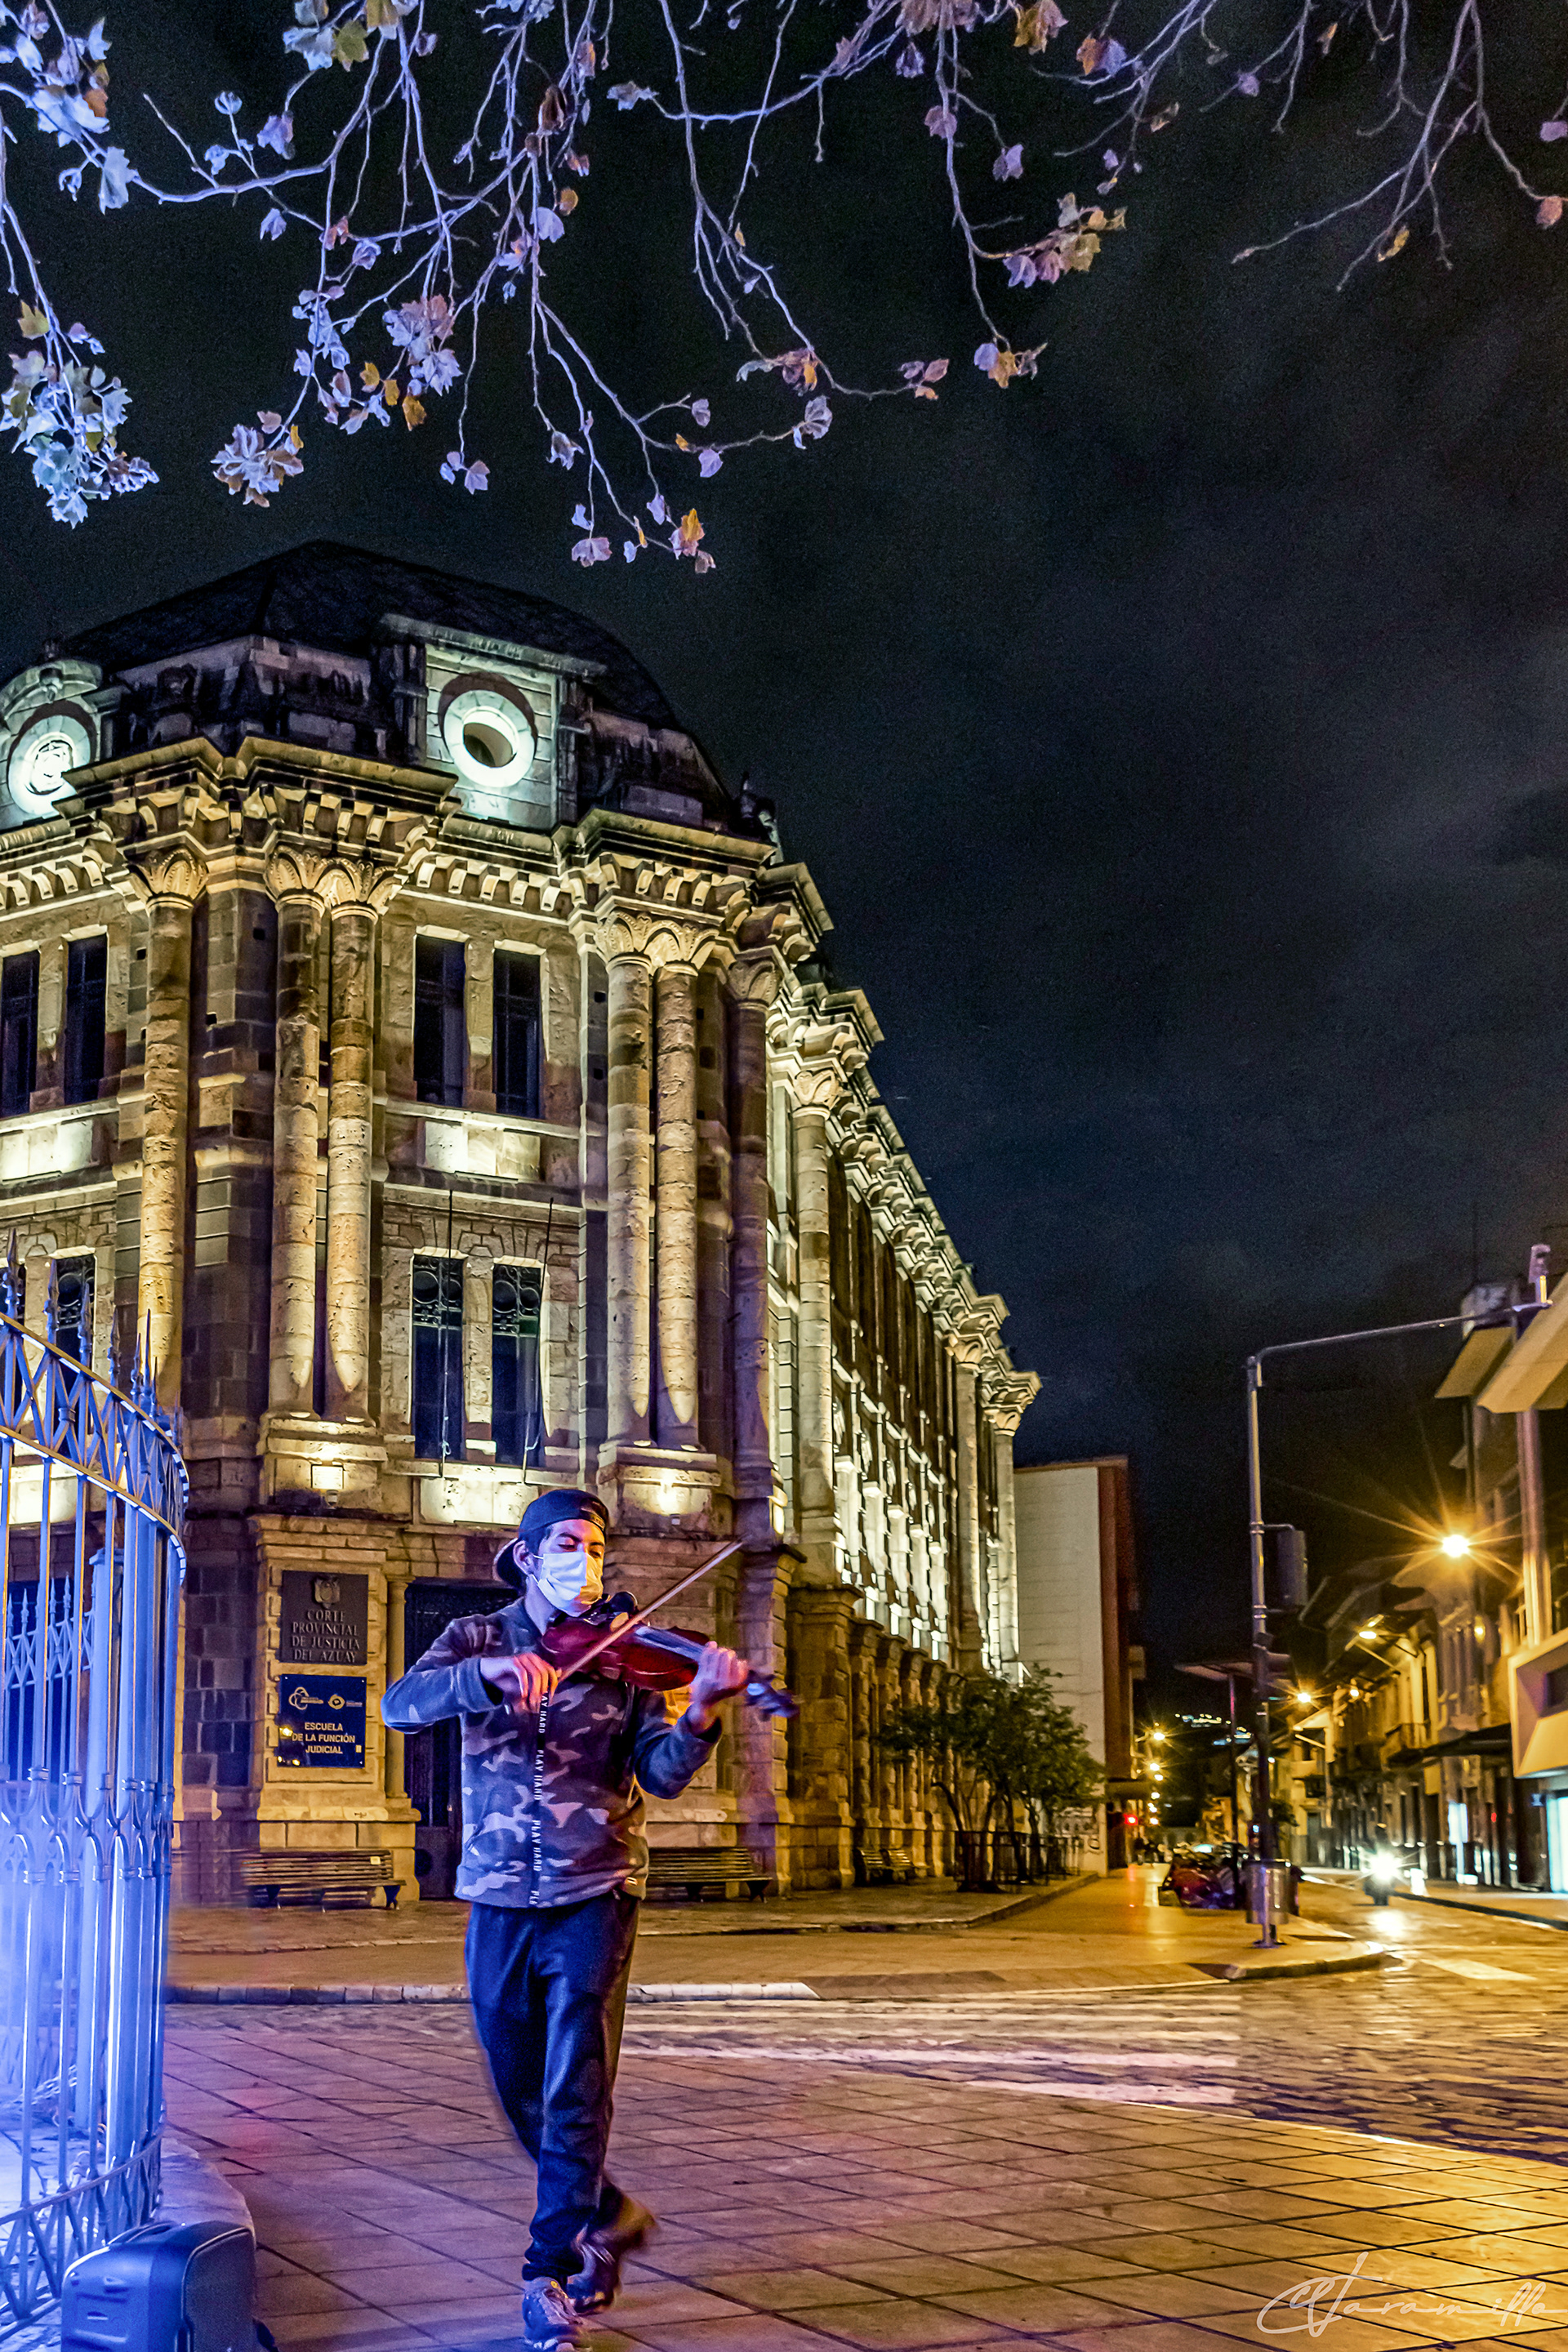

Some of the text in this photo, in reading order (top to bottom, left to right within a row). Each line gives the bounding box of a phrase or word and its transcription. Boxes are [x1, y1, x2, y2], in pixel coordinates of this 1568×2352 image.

[307, 1609, 345, 1622] CORTE
[292, 1621, 357, 1636] PROVINCIAL
[292, 1635, 359, 1650] DE JUSTICIA
[294, 1649, 355, 1663] DEL AZUAY
[304, 1722, 343, 1731] ESCUELA
[538, 1710, 547, 1734] HARD
[292, 1733, 303, 1741] DE
[305, 1733, 316, 1742] LA
[305, 1745, 343, 1754] JUDICIAL
[533, 1749, 544, 1801] PLAY HARD
[531, 1820, 542, 1872] PLAY HARD
